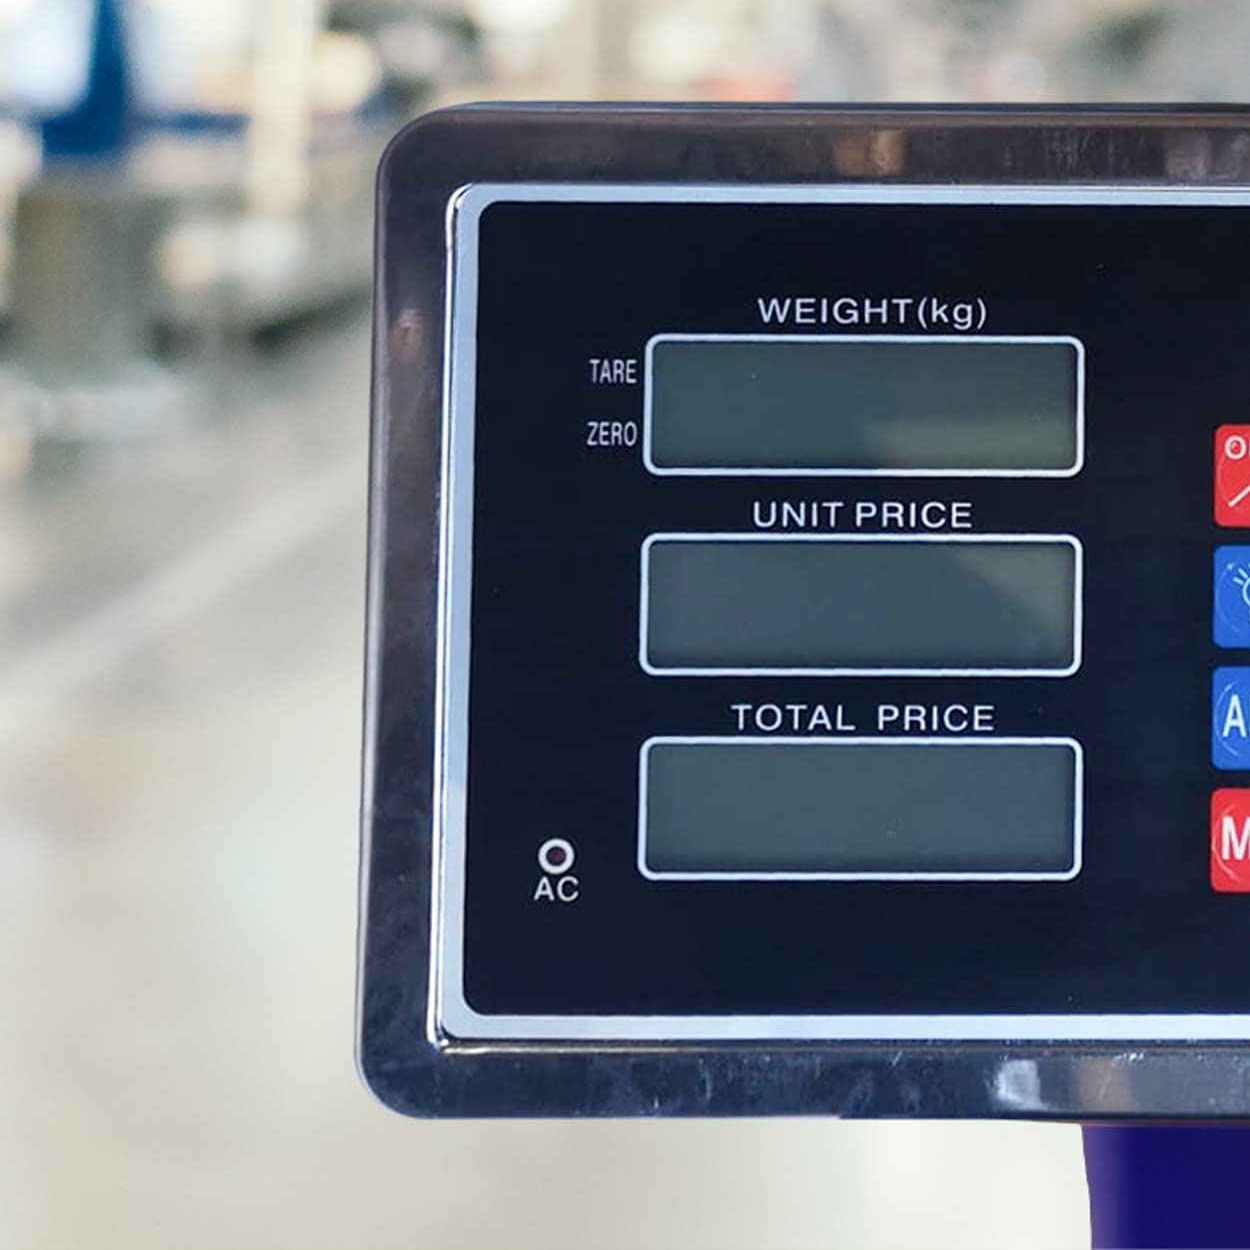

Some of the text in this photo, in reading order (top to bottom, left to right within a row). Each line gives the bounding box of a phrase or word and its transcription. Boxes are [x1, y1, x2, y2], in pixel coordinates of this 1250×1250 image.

[758, 298, 987, 330] WEIGHT(kg)
[590, 359, 637, 383] TARE
[587, 421, 637, 446] ZERO
[753, 502, 971, 528] UNIT PRICE
[732, 704, 995, 731] TOTAL PRICE
[534, 878, 579, 901] AC
